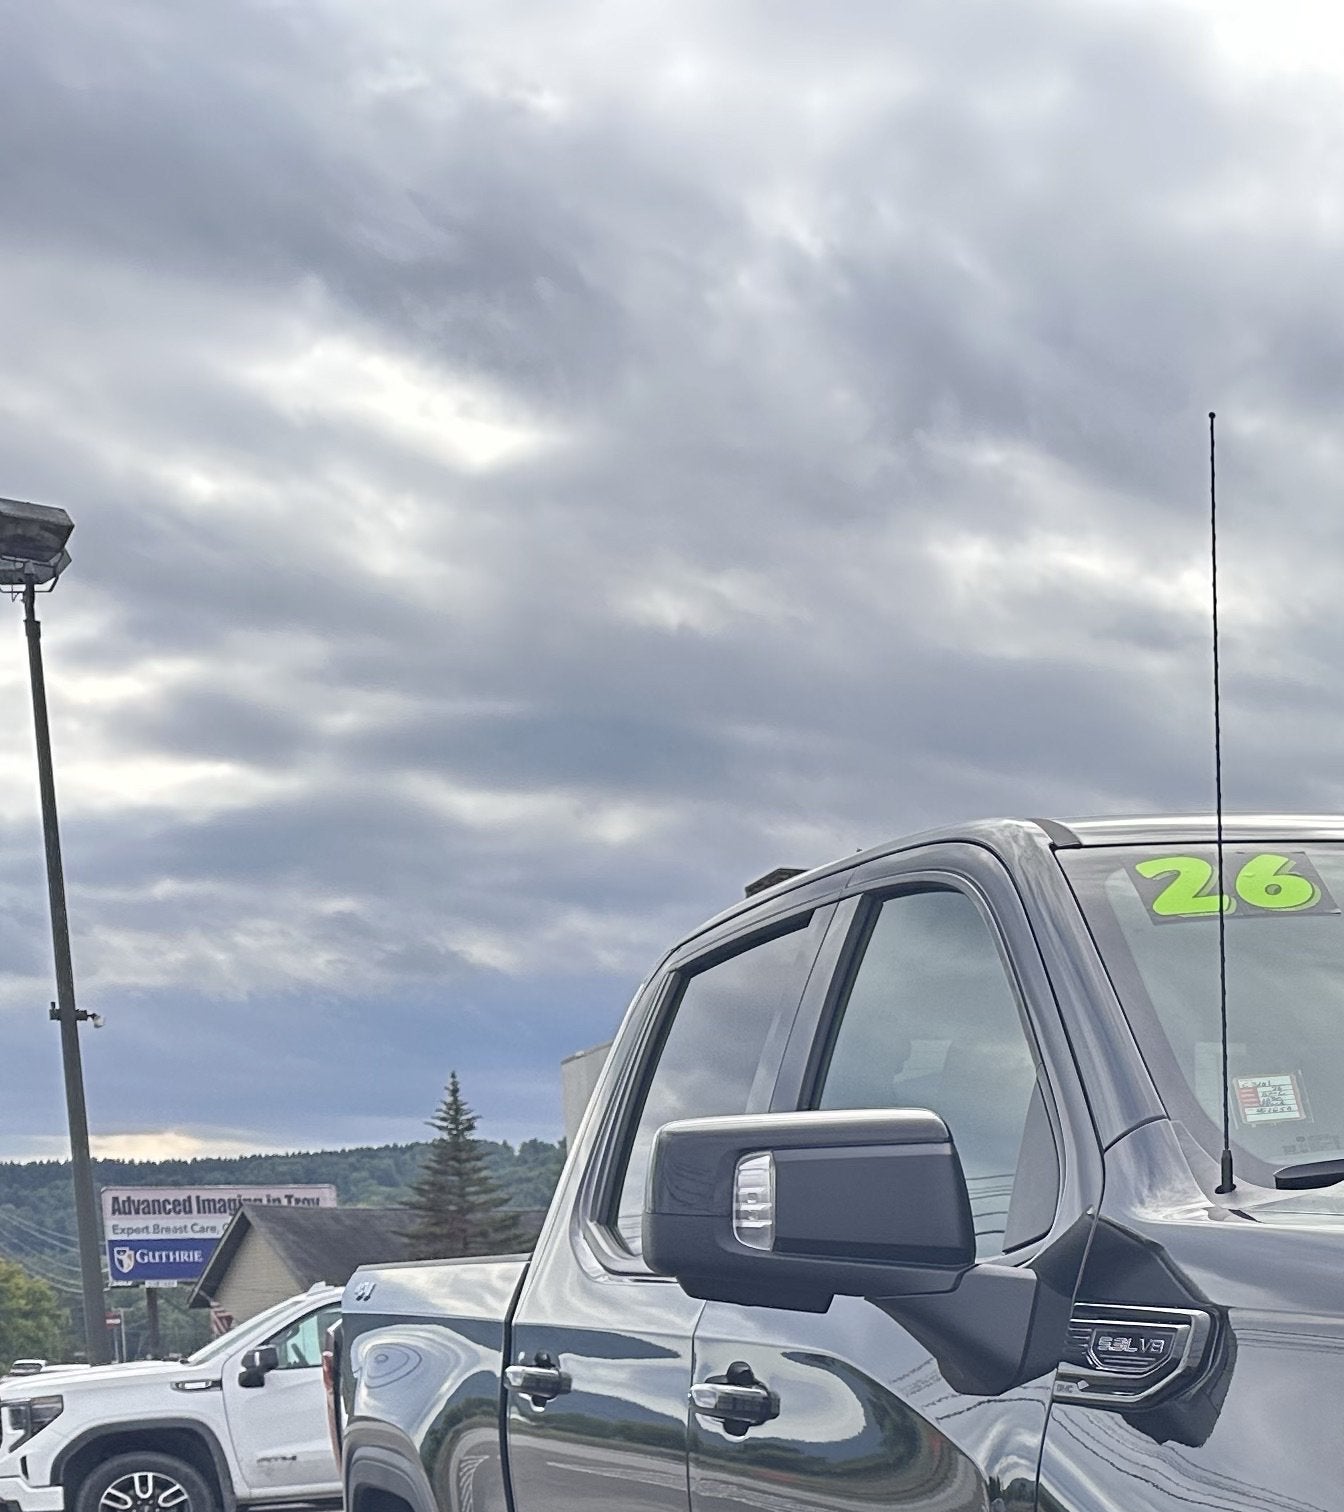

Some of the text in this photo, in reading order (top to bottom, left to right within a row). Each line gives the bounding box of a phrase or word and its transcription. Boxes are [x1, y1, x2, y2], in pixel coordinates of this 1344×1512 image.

[1135, 853, 1322, 917] 26
[111, 1195, 193, 1216] Advanced
[111, 1224, 149, 1237] Expert
[152, 1224, 188, 1235] Breast
[190, 1223, 220, 1236] Care,
